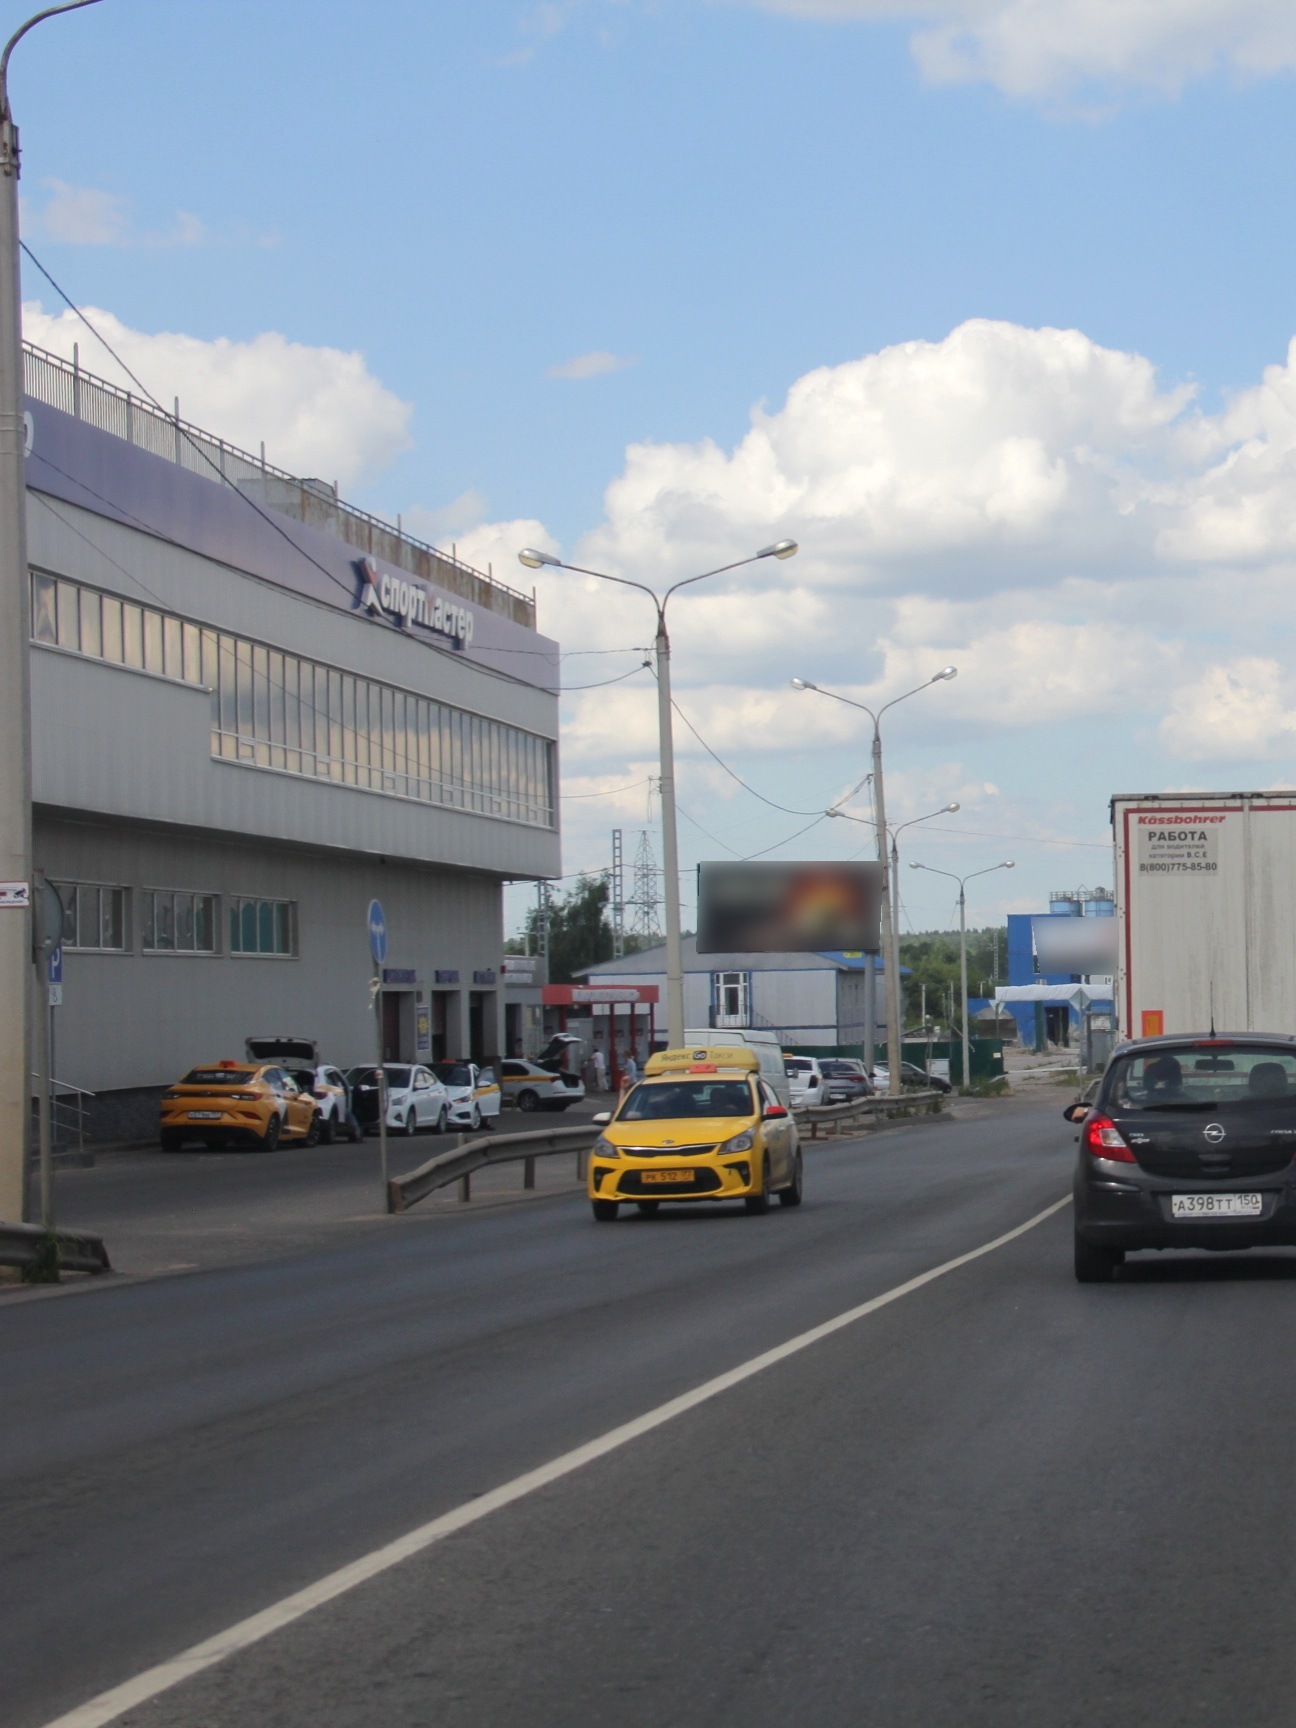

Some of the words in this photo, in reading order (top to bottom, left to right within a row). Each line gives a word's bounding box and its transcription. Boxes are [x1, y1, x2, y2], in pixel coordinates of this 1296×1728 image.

[1148, 831, 1208, 842] РАБОТА
[1140, 862, 1218, 872] 8(800)775-85-80
[694, 1050, 706, 1060] Go
[1177, 1195, 1233, 1212] А398ТТ
[1237, 1194, 1259, 1206] 150
